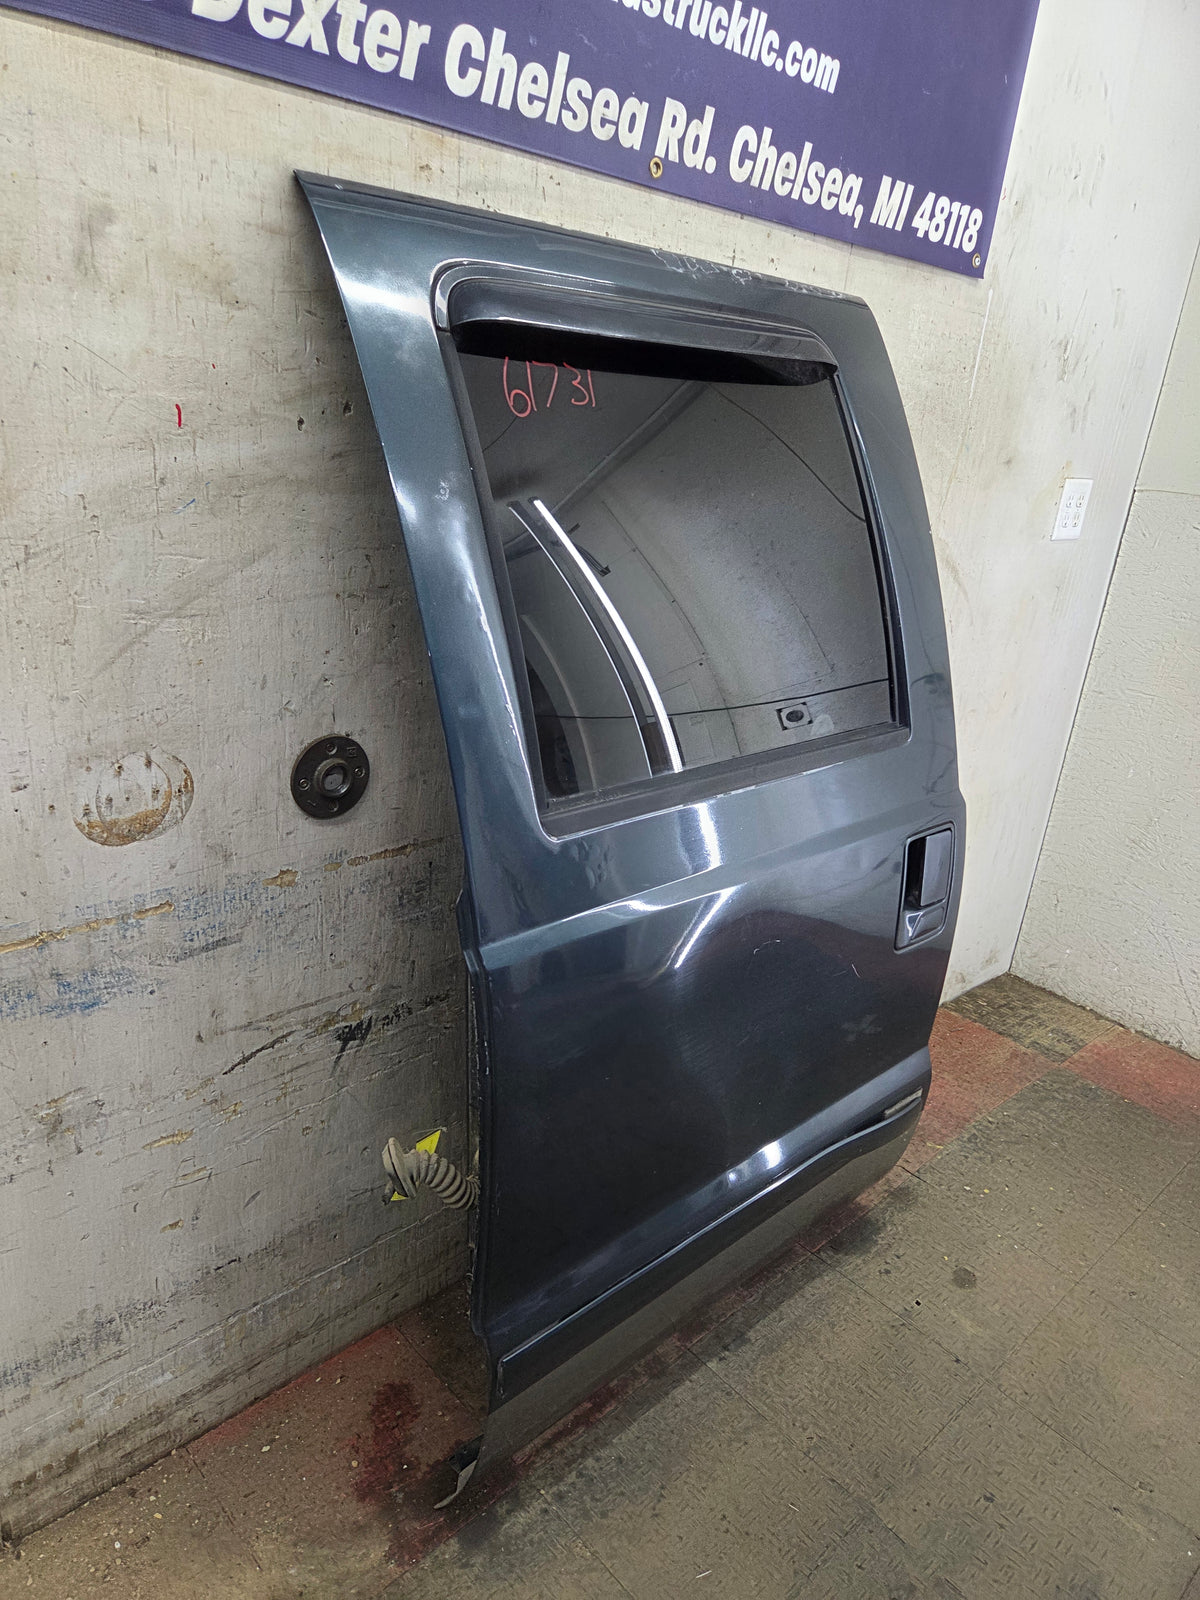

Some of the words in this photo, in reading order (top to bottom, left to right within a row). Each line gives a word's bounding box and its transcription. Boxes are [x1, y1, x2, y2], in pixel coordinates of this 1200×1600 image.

[611, 0, 840, 95] truckllc.com
[190, 0, 431, 81] exter
[444, 23, 650, 152] Chelsea
[654, 97, 717, 175] Rd.
[728, 124, 864, 230] Chelsea,
[869, 174, 915, 232] MI
[911, 191, 984, 254] 48118
[502, 356, 596, 418] 61731
